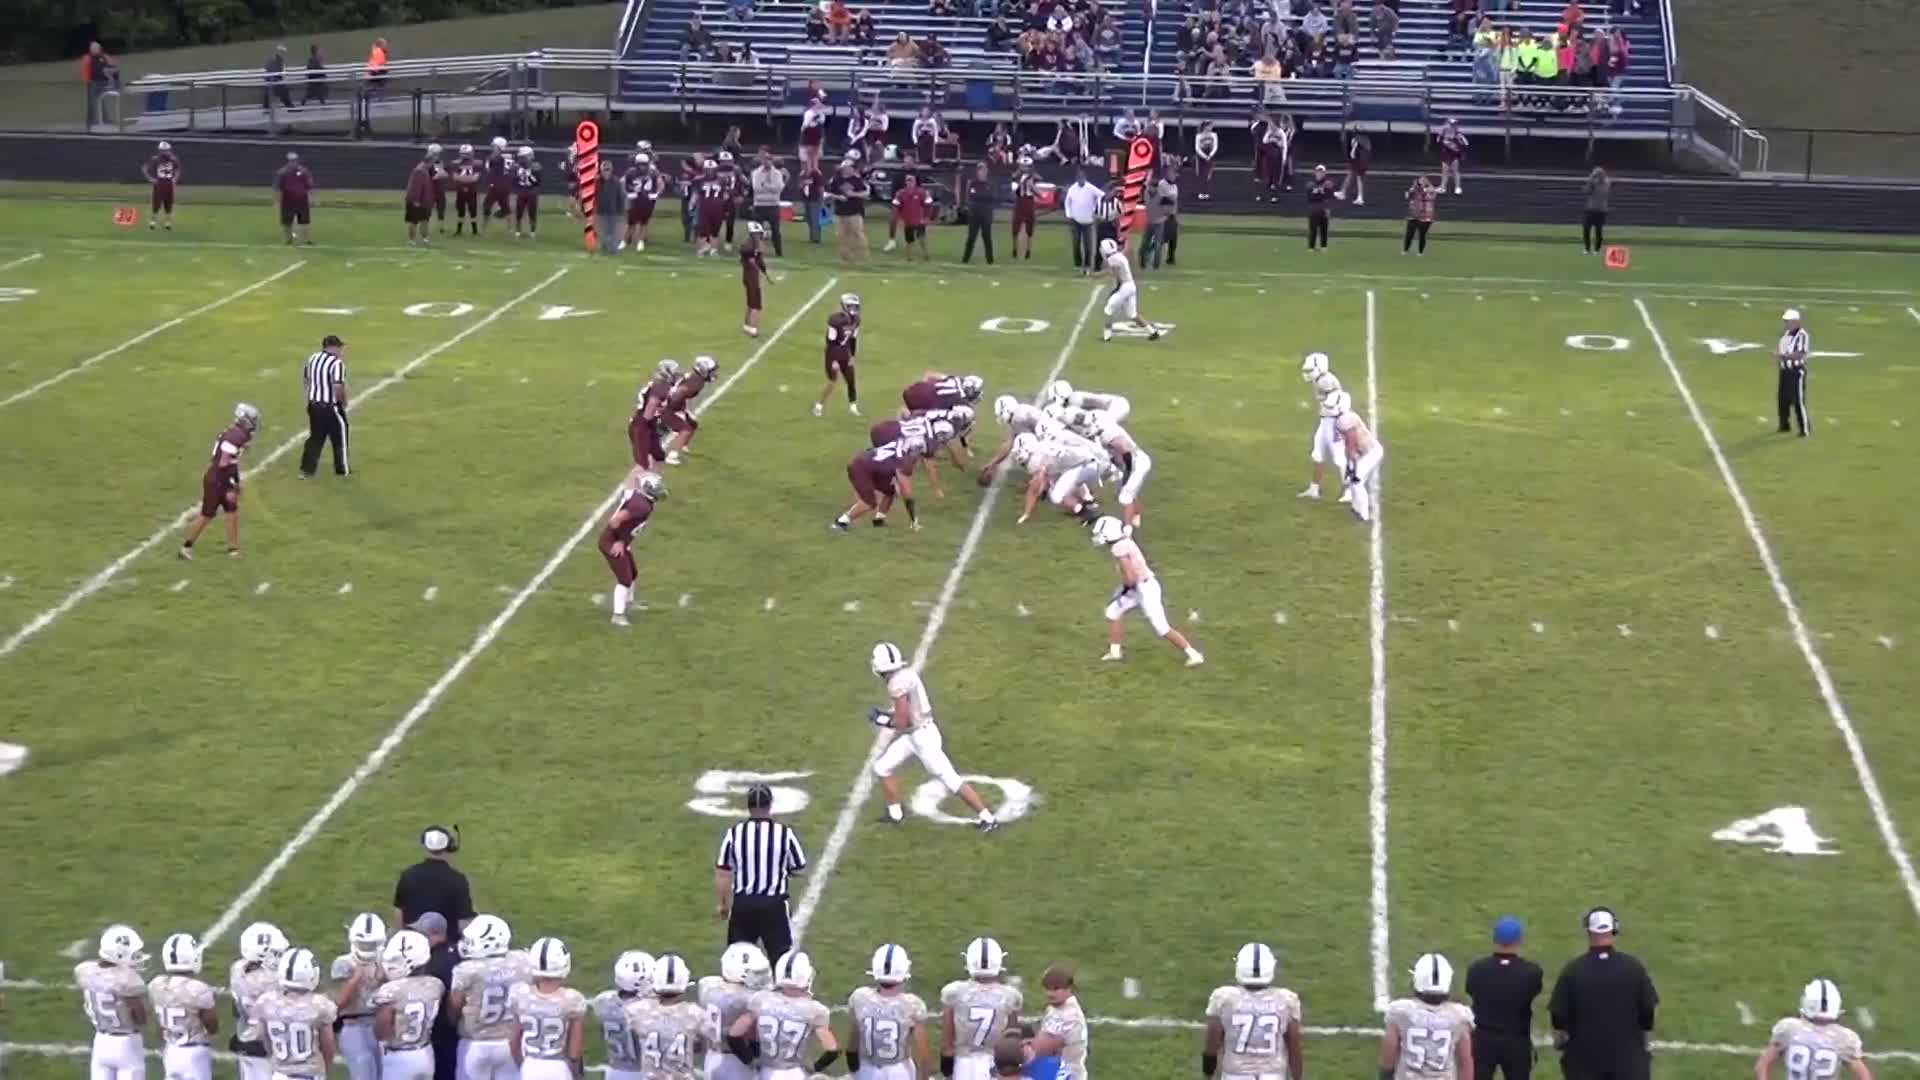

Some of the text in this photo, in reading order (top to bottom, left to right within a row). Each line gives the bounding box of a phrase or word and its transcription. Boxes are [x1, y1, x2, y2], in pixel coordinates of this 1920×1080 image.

[267, 1020, 314, 1061] 60
[759, 1014, 808, 1059] 37
[862, 1016, 900, 1058] 13
[969, 1008, 996, 1047] 7
[1231, 1014, 1281, 1054] 73
[645, 1031, 688, 1068] 44
[1406, 1027, 1453, 1070] 53
